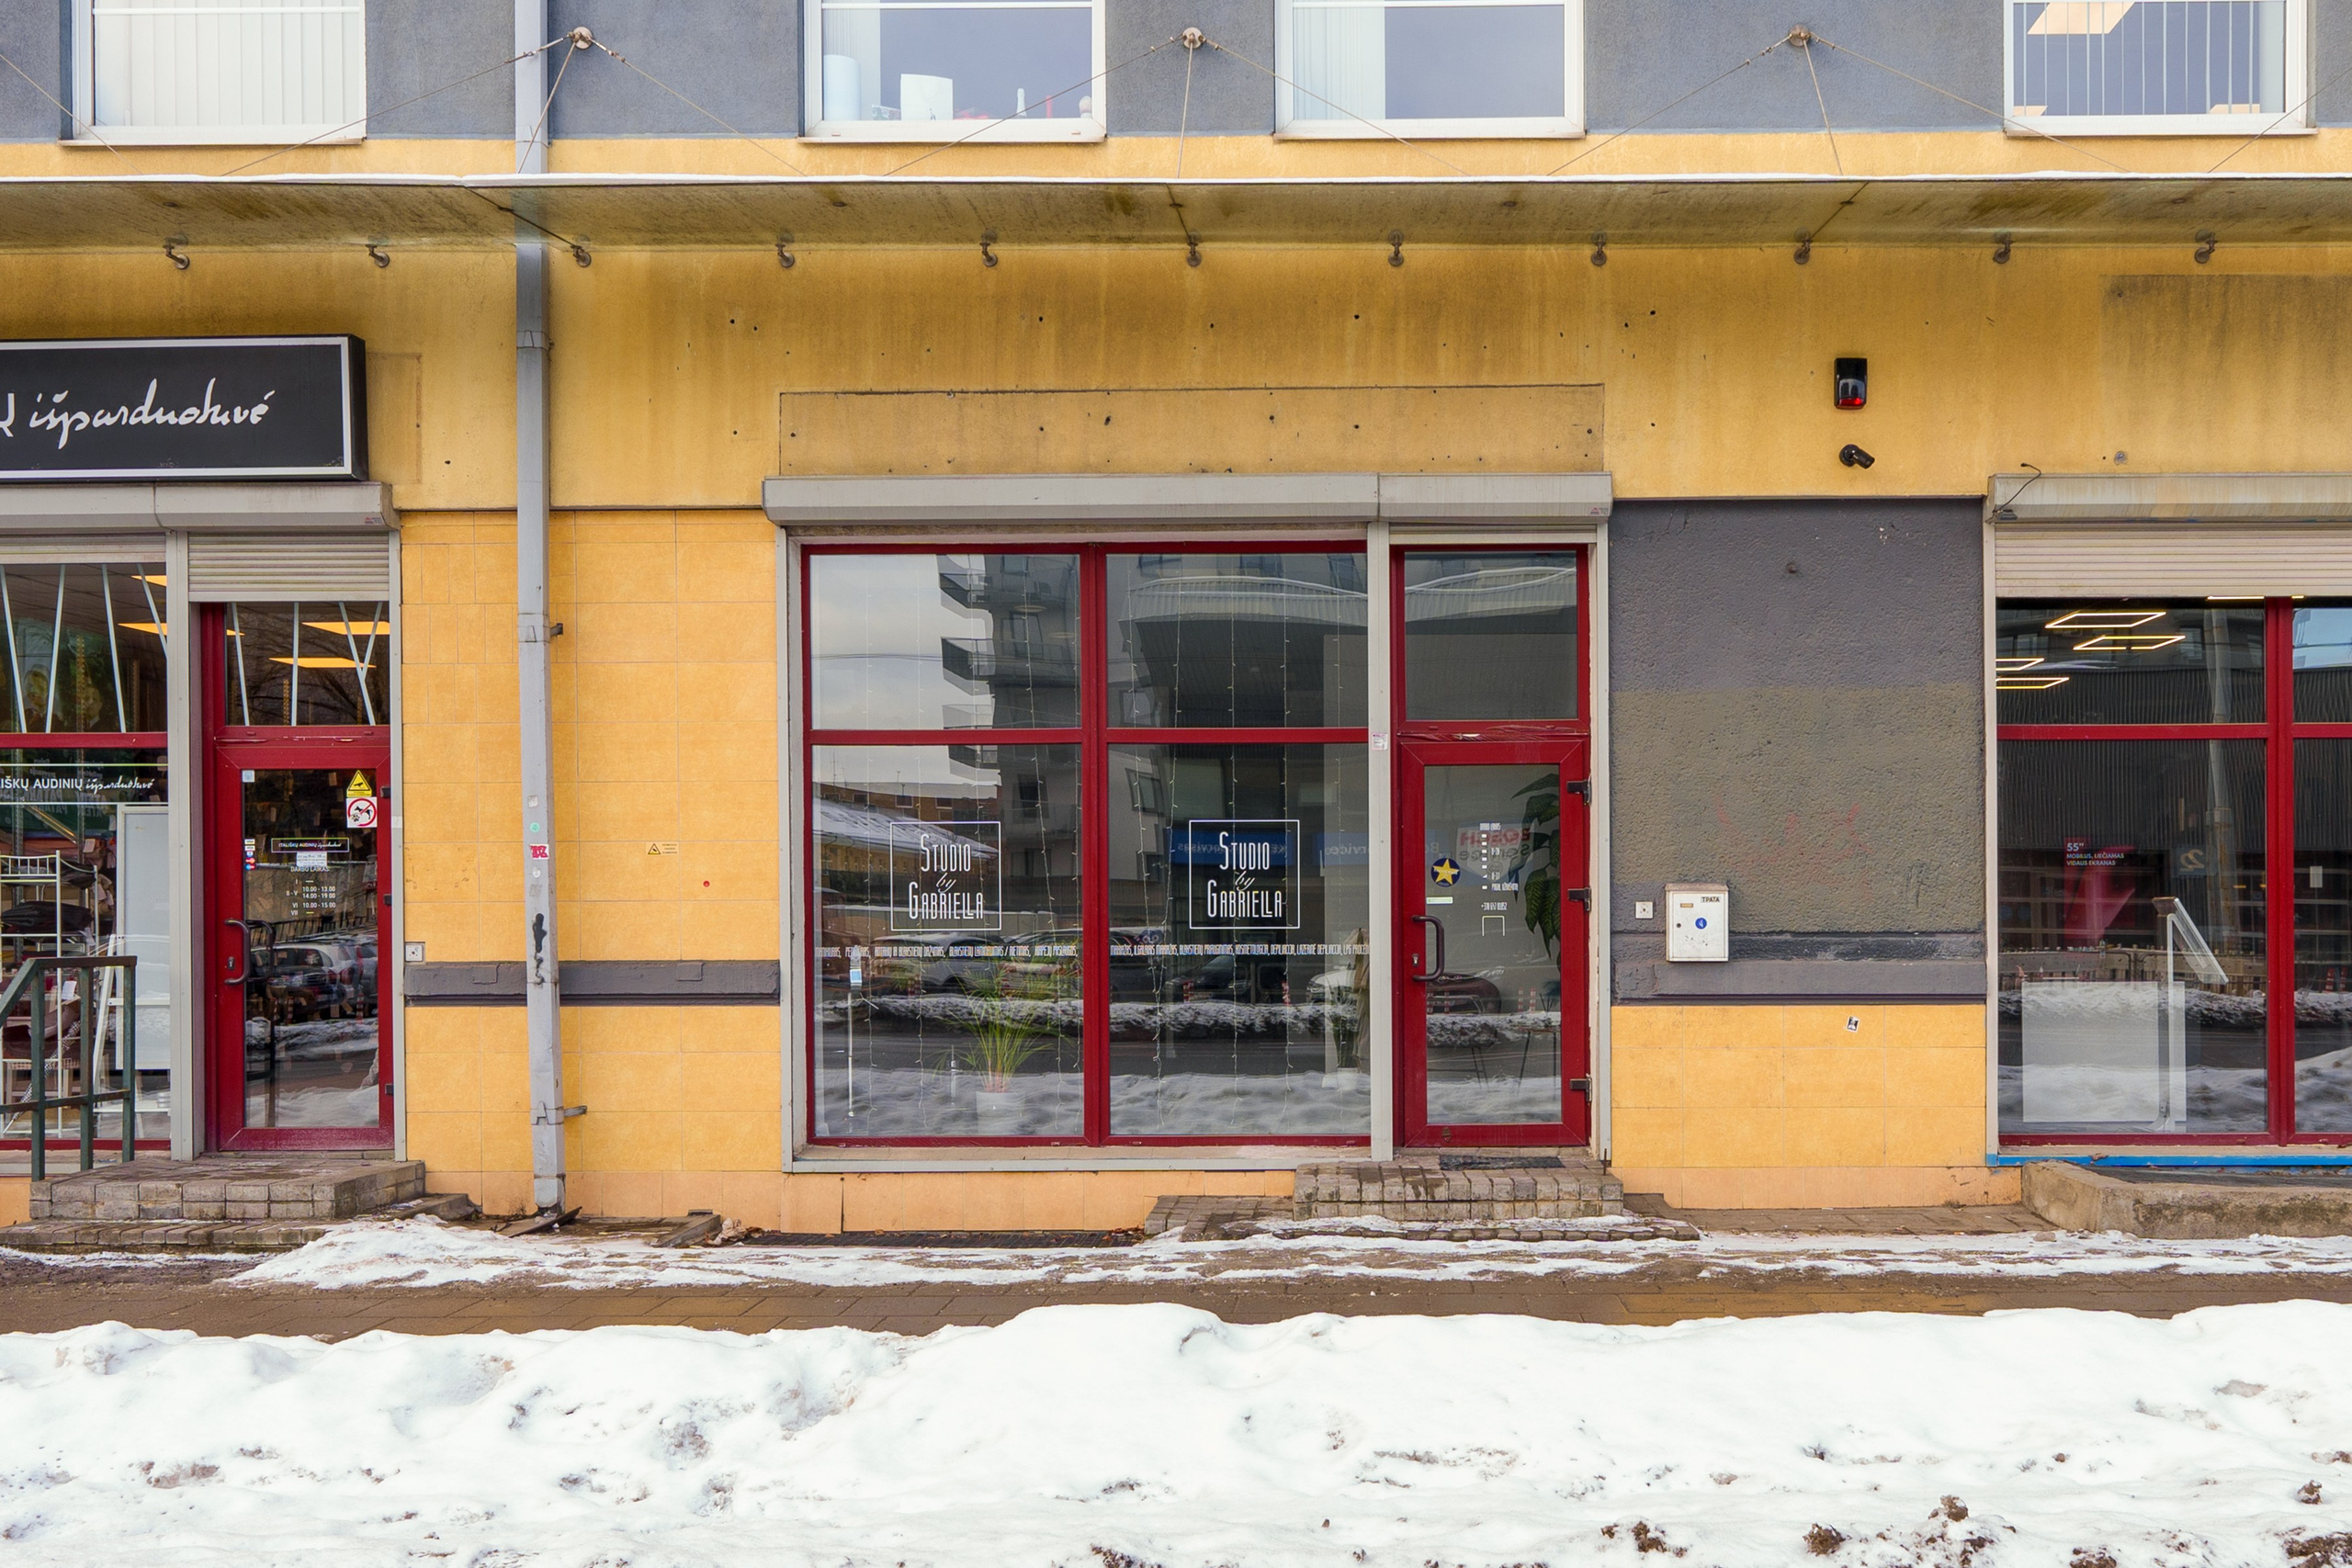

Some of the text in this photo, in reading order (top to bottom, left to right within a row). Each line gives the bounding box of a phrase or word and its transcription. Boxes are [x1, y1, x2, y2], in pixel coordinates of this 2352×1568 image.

[33, 778, 83, 791] AUDINIŲ
[935, 873, 956, 893] by
[1235, 870, 1255, 892] by
